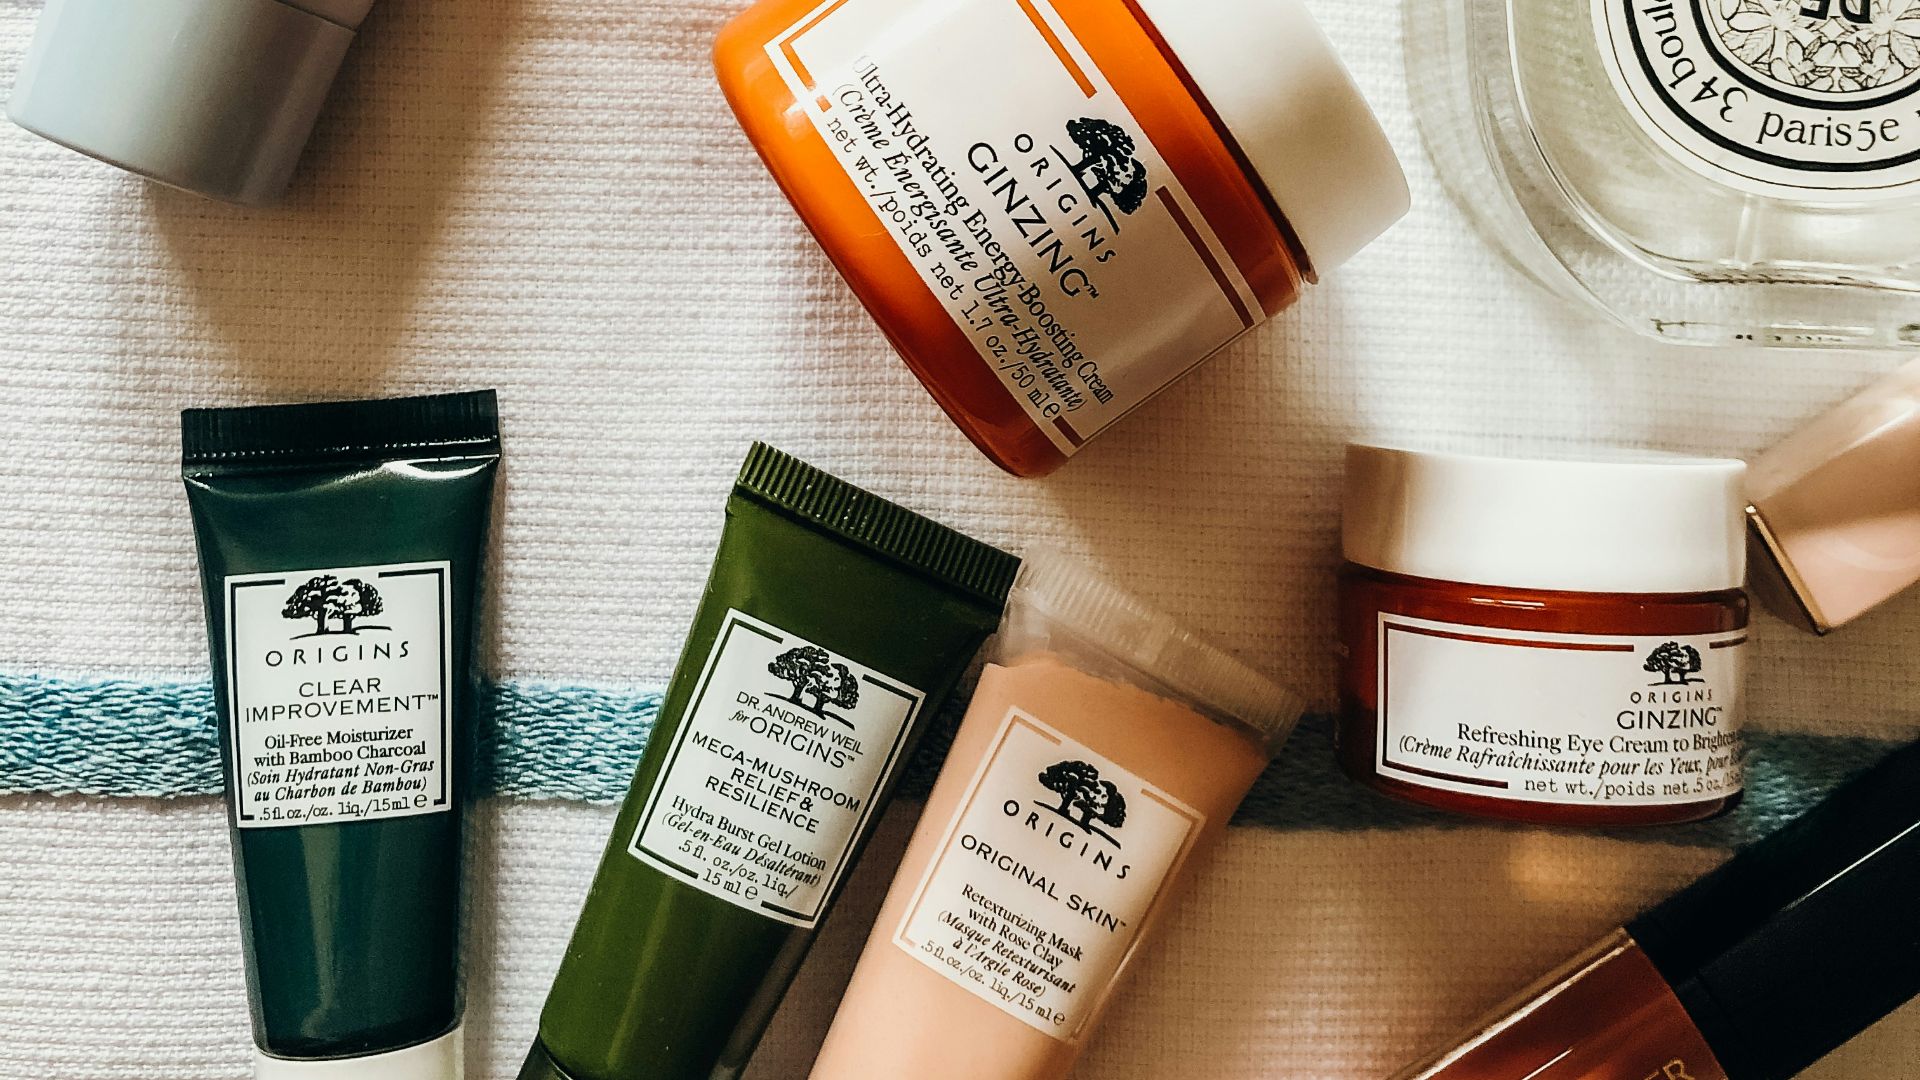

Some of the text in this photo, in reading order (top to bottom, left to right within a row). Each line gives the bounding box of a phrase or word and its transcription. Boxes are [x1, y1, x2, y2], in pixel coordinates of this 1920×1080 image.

[1642, 0, 1748, 123] 34 boul
[827, 117, 858, 153] net
[855, 155, 932, 258] wt./poids
[930, 261, 964, 301] net
[961, 300, 993, 332] 1.7
[1014, 133, 1116, 262] ORIGINS
[832, 83, 890, 150] (Crème
[974, 272, 1088, 412] Ultra-Hydratante)
[852, 55, 1115, 405] Ultra-Hydrating Energy-Boosting Cream
[265, 640, 409, 667] ORIGINS
[298, 677, 382, 698] CLEAR
[729, 709, 750, 725] for
[1630, 688, 1712, 705] ORIGINS
[254, 741, 426, 767] with Bamboo Charcoal
[264, 725, 414, 750] Oil-Free Moisturizer
[736, 690, 864, 756] DR. ANDREW WEIL
[1457, 722, 1562, 754] Refreshing
[1567, 732, 1604, 757] Eye
[1609, 733, 1669, 755] Cream
[1672, 735, 1690, 753] to
[247, 759, 435, 788] (Soin Hydratant Non-Gras
[692, 730, 861, 813] MEGA-MUSHROOM
[1398, 734, 1453, 760] (Crème
[1456, 744, 1595, 776] Rafraîchissante
[1599, 758, 1641, 779] pour
[1644, 755, 1665, 775] les
[254, 776, 428, 803] au Charbon de Bambou)
[705, 775, 820, 834] RESILIENCE
[1524, 777, 1558, 794] net
[1565, 780, 1655, 801] wt./poids
[1662, 783, 1689, 796] net
[661, 811, 822, 888] (Gel-en-Eau Désaltérant)
[671, 796, 828, 871] Hydra Burst Gel Lotion
[1003, 799, 1131, 880] ORIGINS
[960, 834, 1059, 901] ORIGINAL
[937, 910, 1077, 994] (Masque Retexturisant
[961, 883, 1084, 962] Retexturizing Mask
[968, 908, 1064, 971] with Rose Clay
[952, 937, 964, 950] à
[1012, 971, 1047, 998] Rose)
